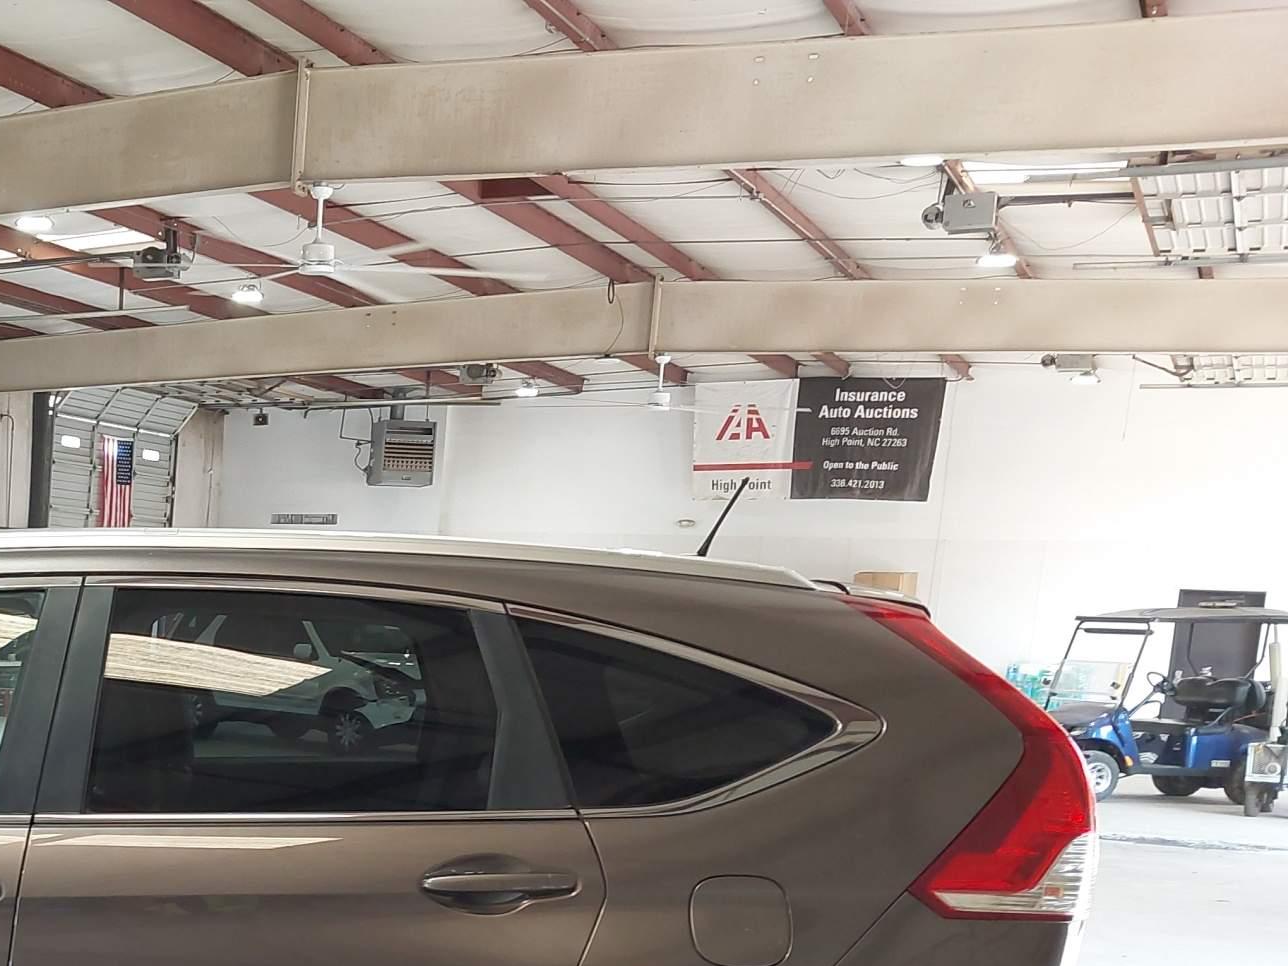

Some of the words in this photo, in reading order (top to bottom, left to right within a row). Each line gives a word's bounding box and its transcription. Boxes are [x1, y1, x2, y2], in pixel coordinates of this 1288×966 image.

[835, 388, 906, 402] Insurance
[818, 405, 851, 419] Auto
[854, 405, 919, 419] Auctions
[851, 426, 885, 436] Auction
[886, 427, 900, 436] Rd.
[821, 437, 840, 447] High
[841, 437, 865, 448] Point,
[866, 437, 881, 447] NC
[823, 460, 844, 471] Open
[845, 461, 854, 470] to
[855, 461, 870, 470] the
[871, 461, 899, 470] Public
[711, 479, 737, 493] High
[740, 478, 772, 491] oint
